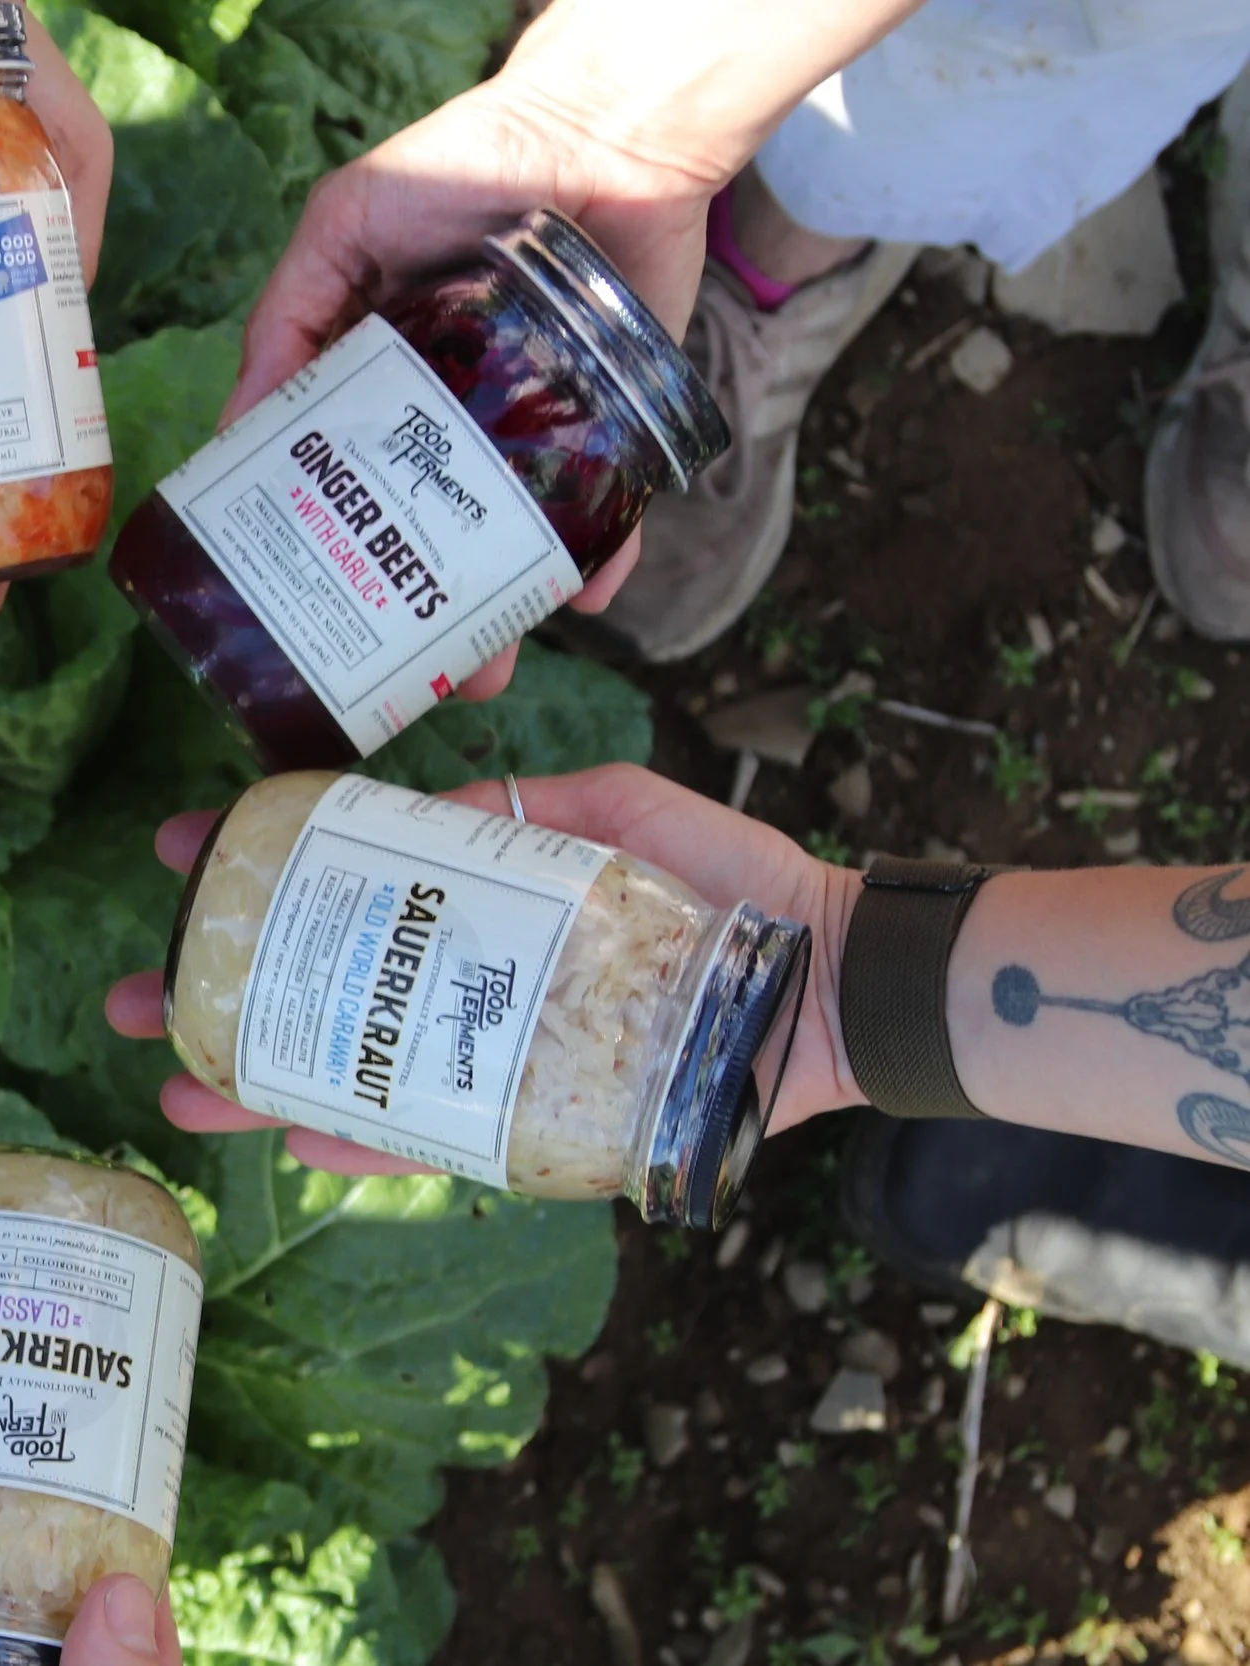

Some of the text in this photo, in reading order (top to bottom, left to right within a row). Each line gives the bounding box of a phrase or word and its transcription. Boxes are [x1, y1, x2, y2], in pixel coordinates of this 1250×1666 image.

[392, 403, 453, 456] FOOD
[389, 434, 486, 521] FERMENTS
[286, 426, 386, 539] GINGER
[361, 522, 452, 624] BEETS
[290, 491, 387, 604] WITH GARLIC
[323, 893, 395, 1080] OLD WORLD CARAWAY
[352, 881, 446, 1110] SAUERKRAUT
[477, 957, 517, 1026] FOOD
[435, 974, 488, 1090] FERMENTS
[21, 1254, 128, 1284] RICH IN PROBIOTICS
[49, 1277, 119, 1301] SMALL BATCH
[9, 1426, 76, 1468] FOOD
